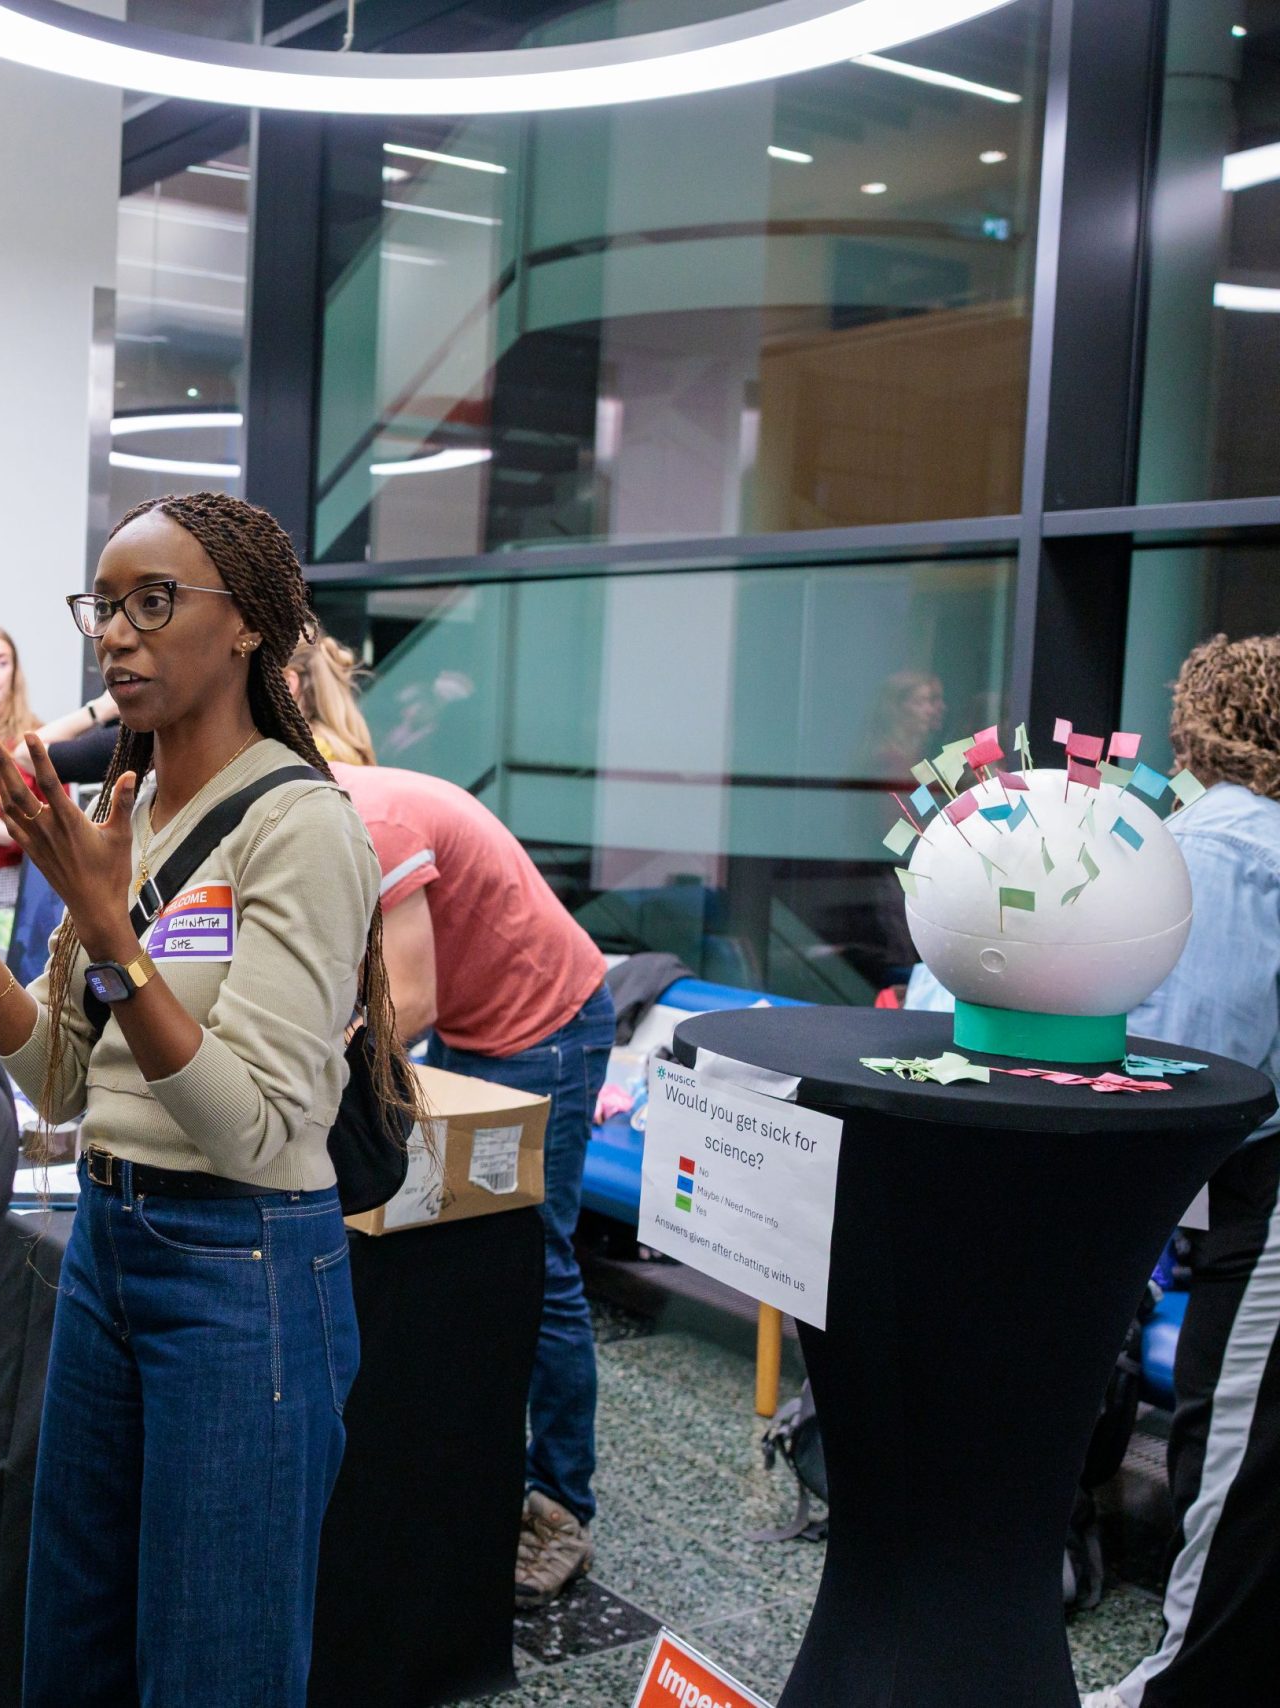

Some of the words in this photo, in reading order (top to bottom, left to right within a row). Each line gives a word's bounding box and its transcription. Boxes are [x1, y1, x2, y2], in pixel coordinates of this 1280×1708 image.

[170, 939, 194, 950] SHE
[665, 1084, 707, 1113] Would
[710, 1104, 733, 1123] you
[736, 1114, 756, 1132] get
[761, 1122, 790, 1145] sick
[795, 1132, 817, 1153] for
[699, 1167, 709, 1178] No
[704, 1136, 764, 1170] science?
[695, 1204, 707, 1217] Yes
[697, 1185, 720, 1203] Maybe
[725, 1197, 744, 1213] Need
[744, 1208, 763, 1222] more
[764, 1215, 779, 1229] info
[655, 1215, 688, 1238] Answers
[689, 1231, 710, 1249] given
[712, 1242, 732, 1260] after
[733, 1252, 770, 1278] chatting
[771, 1269, 791, 1286] with
[793, 1280, 806, 1292] us
[657, 1657, 732, 1708] Impe
